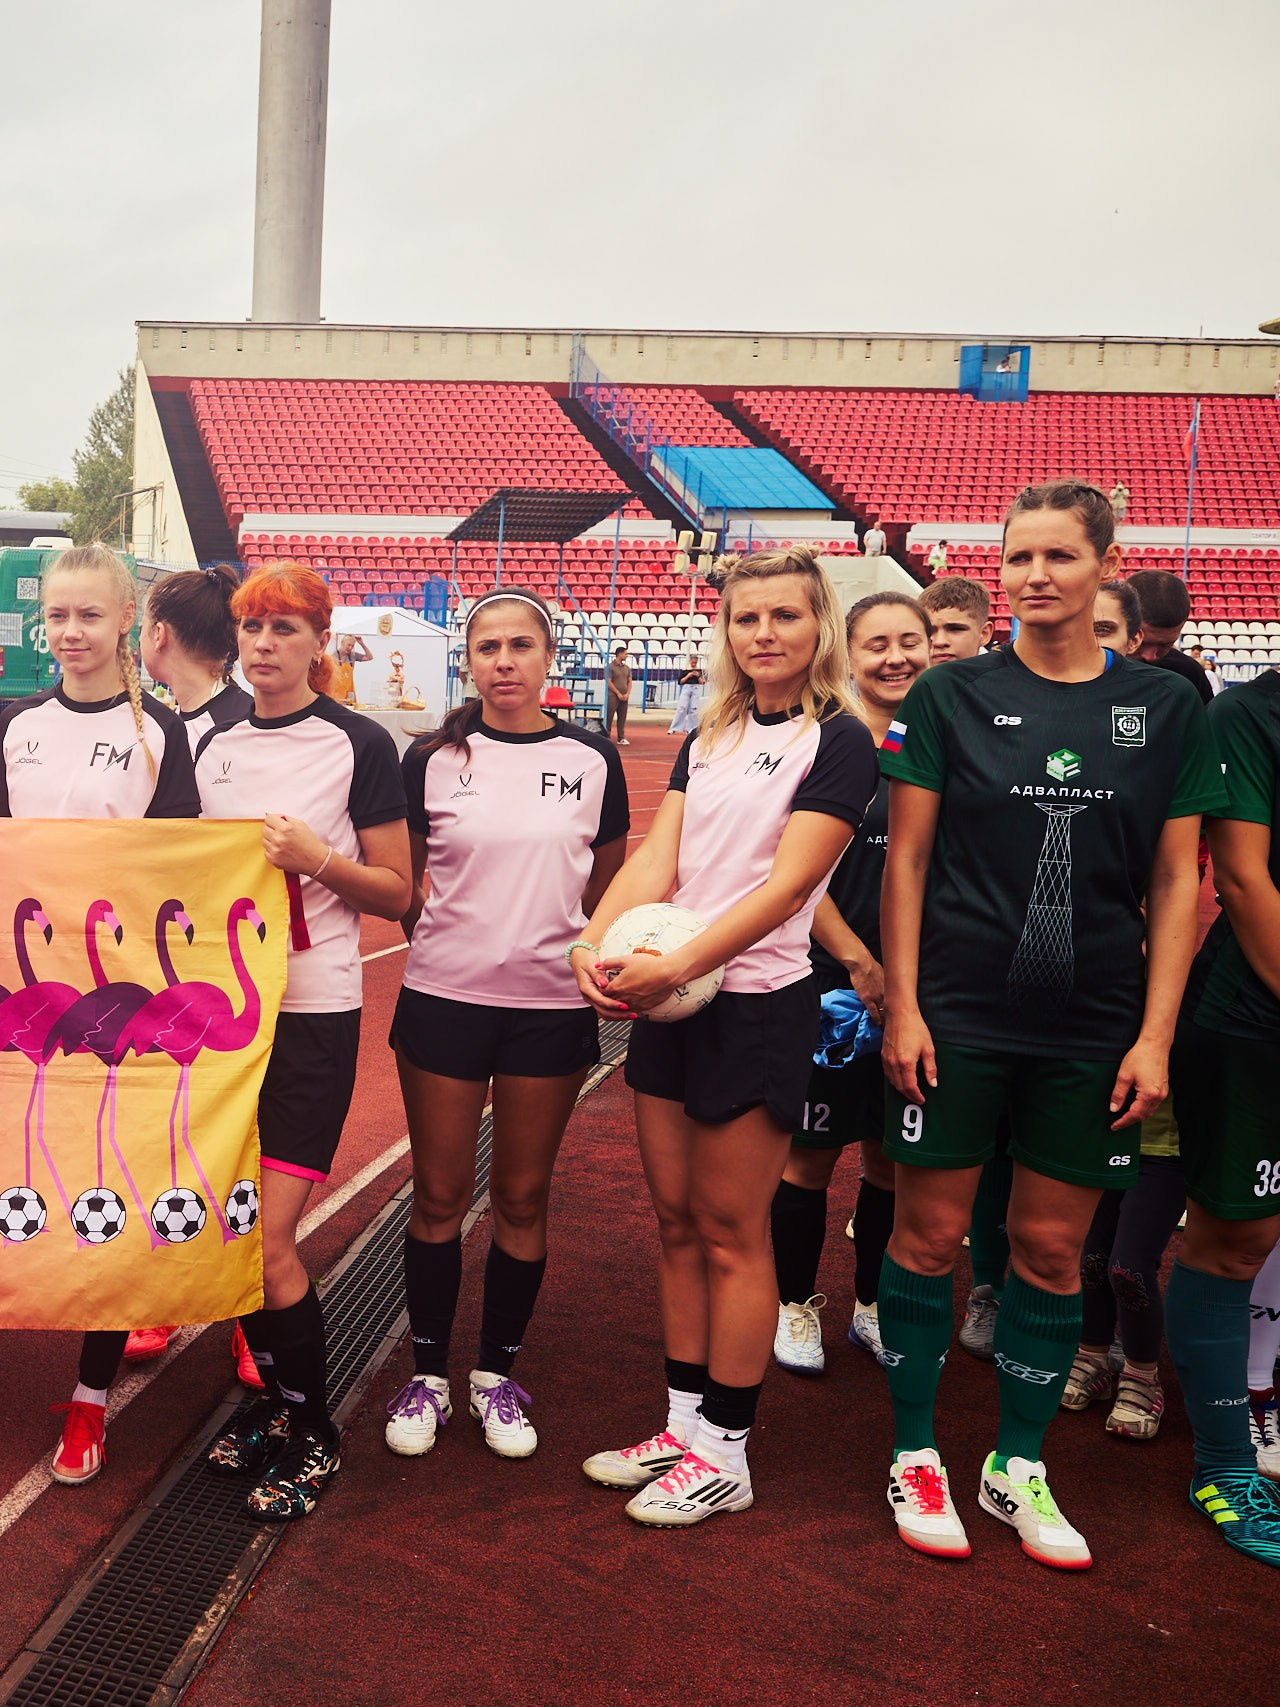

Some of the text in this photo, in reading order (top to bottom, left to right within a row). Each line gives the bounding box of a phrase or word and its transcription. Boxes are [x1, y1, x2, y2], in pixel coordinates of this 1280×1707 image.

[993, 714, 1022, 726] GS
[90, 742, 135, 771] FM
[745, 752, 784, 776] FM
[450, 790, 480, 798] JÖGEL
[541, 772, 584, 801] FM
[1010, 785, 1114, 800] АДВАПЛАСТ
[803, 1101, 830, 1132] 12
[901, 1103, 923, 1143] 9
[1108, 1155, 1131, 1166] GS
[643, 1500, 696, 1512] F50
